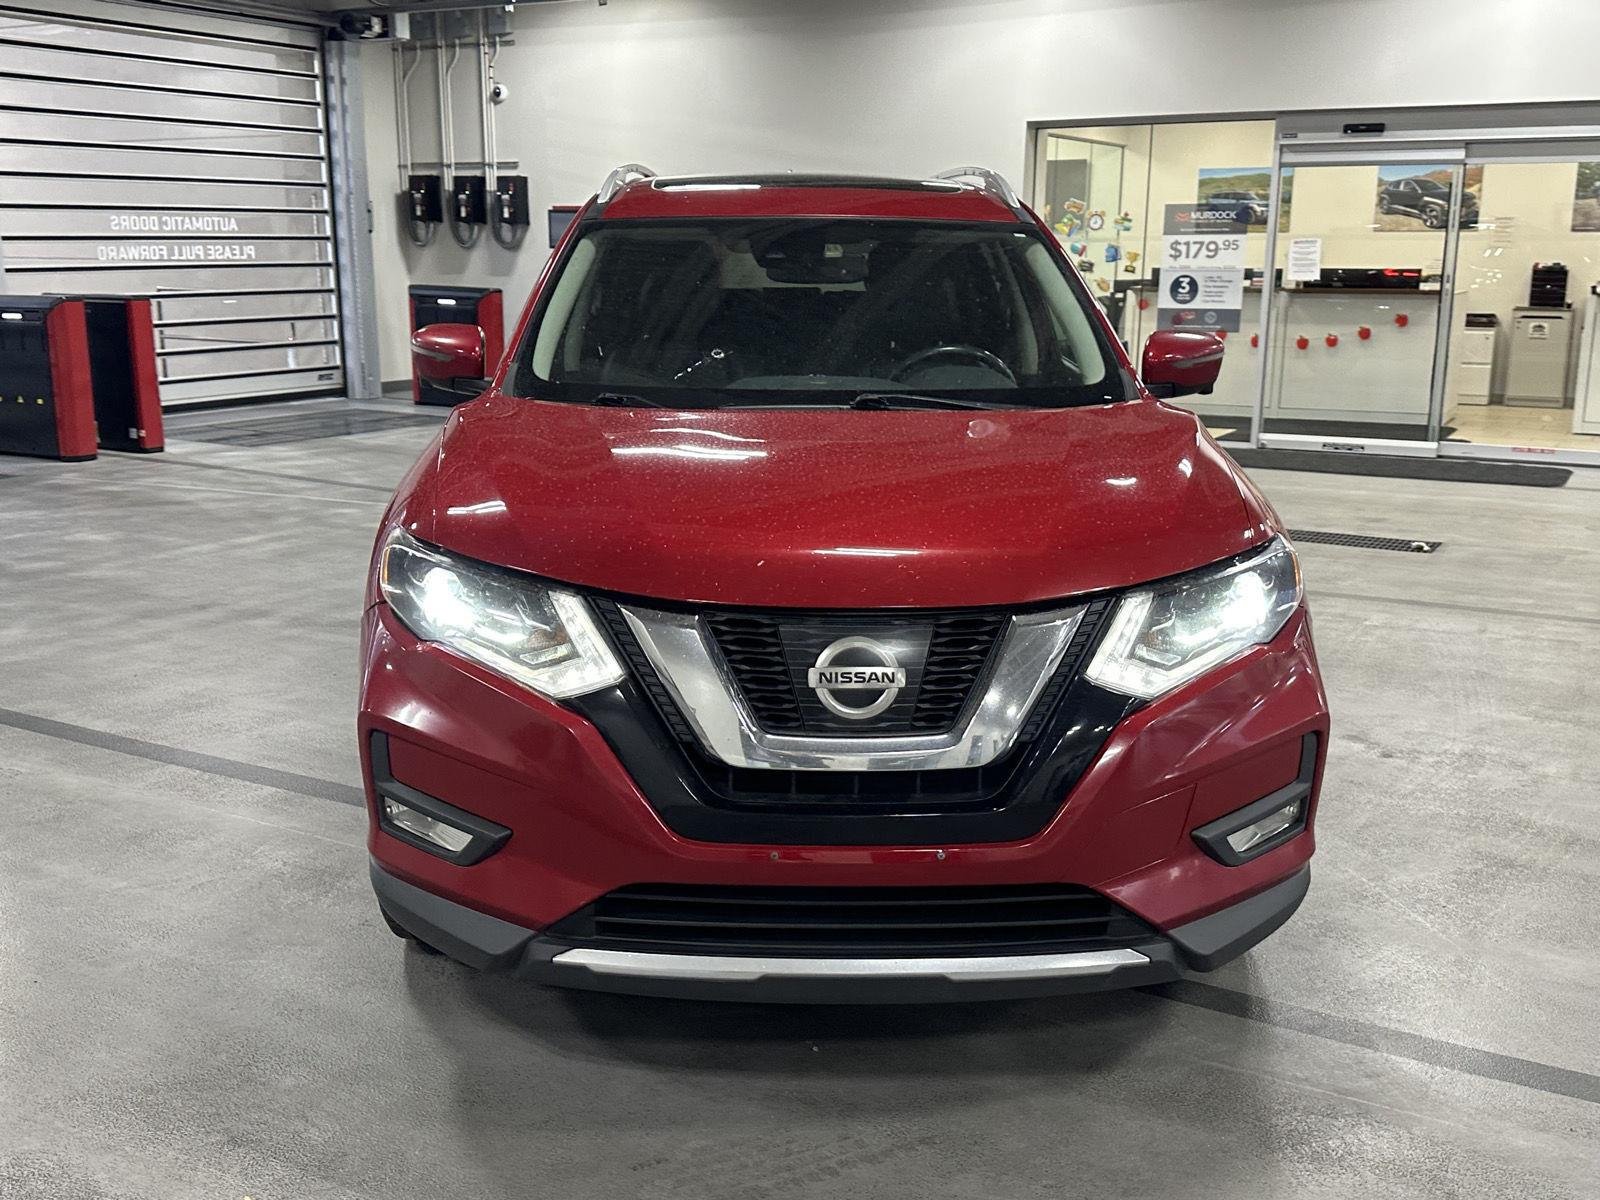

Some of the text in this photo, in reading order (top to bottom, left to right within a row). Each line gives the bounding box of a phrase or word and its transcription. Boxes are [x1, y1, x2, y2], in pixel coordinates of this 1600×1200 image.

[1190, 211, 1237, 219] MURDOCK
[1169, 239, 1239, 261] $179.95
[1177, 277, 1191, 294] 3
[818, 671, 896, 684] NISSAN
